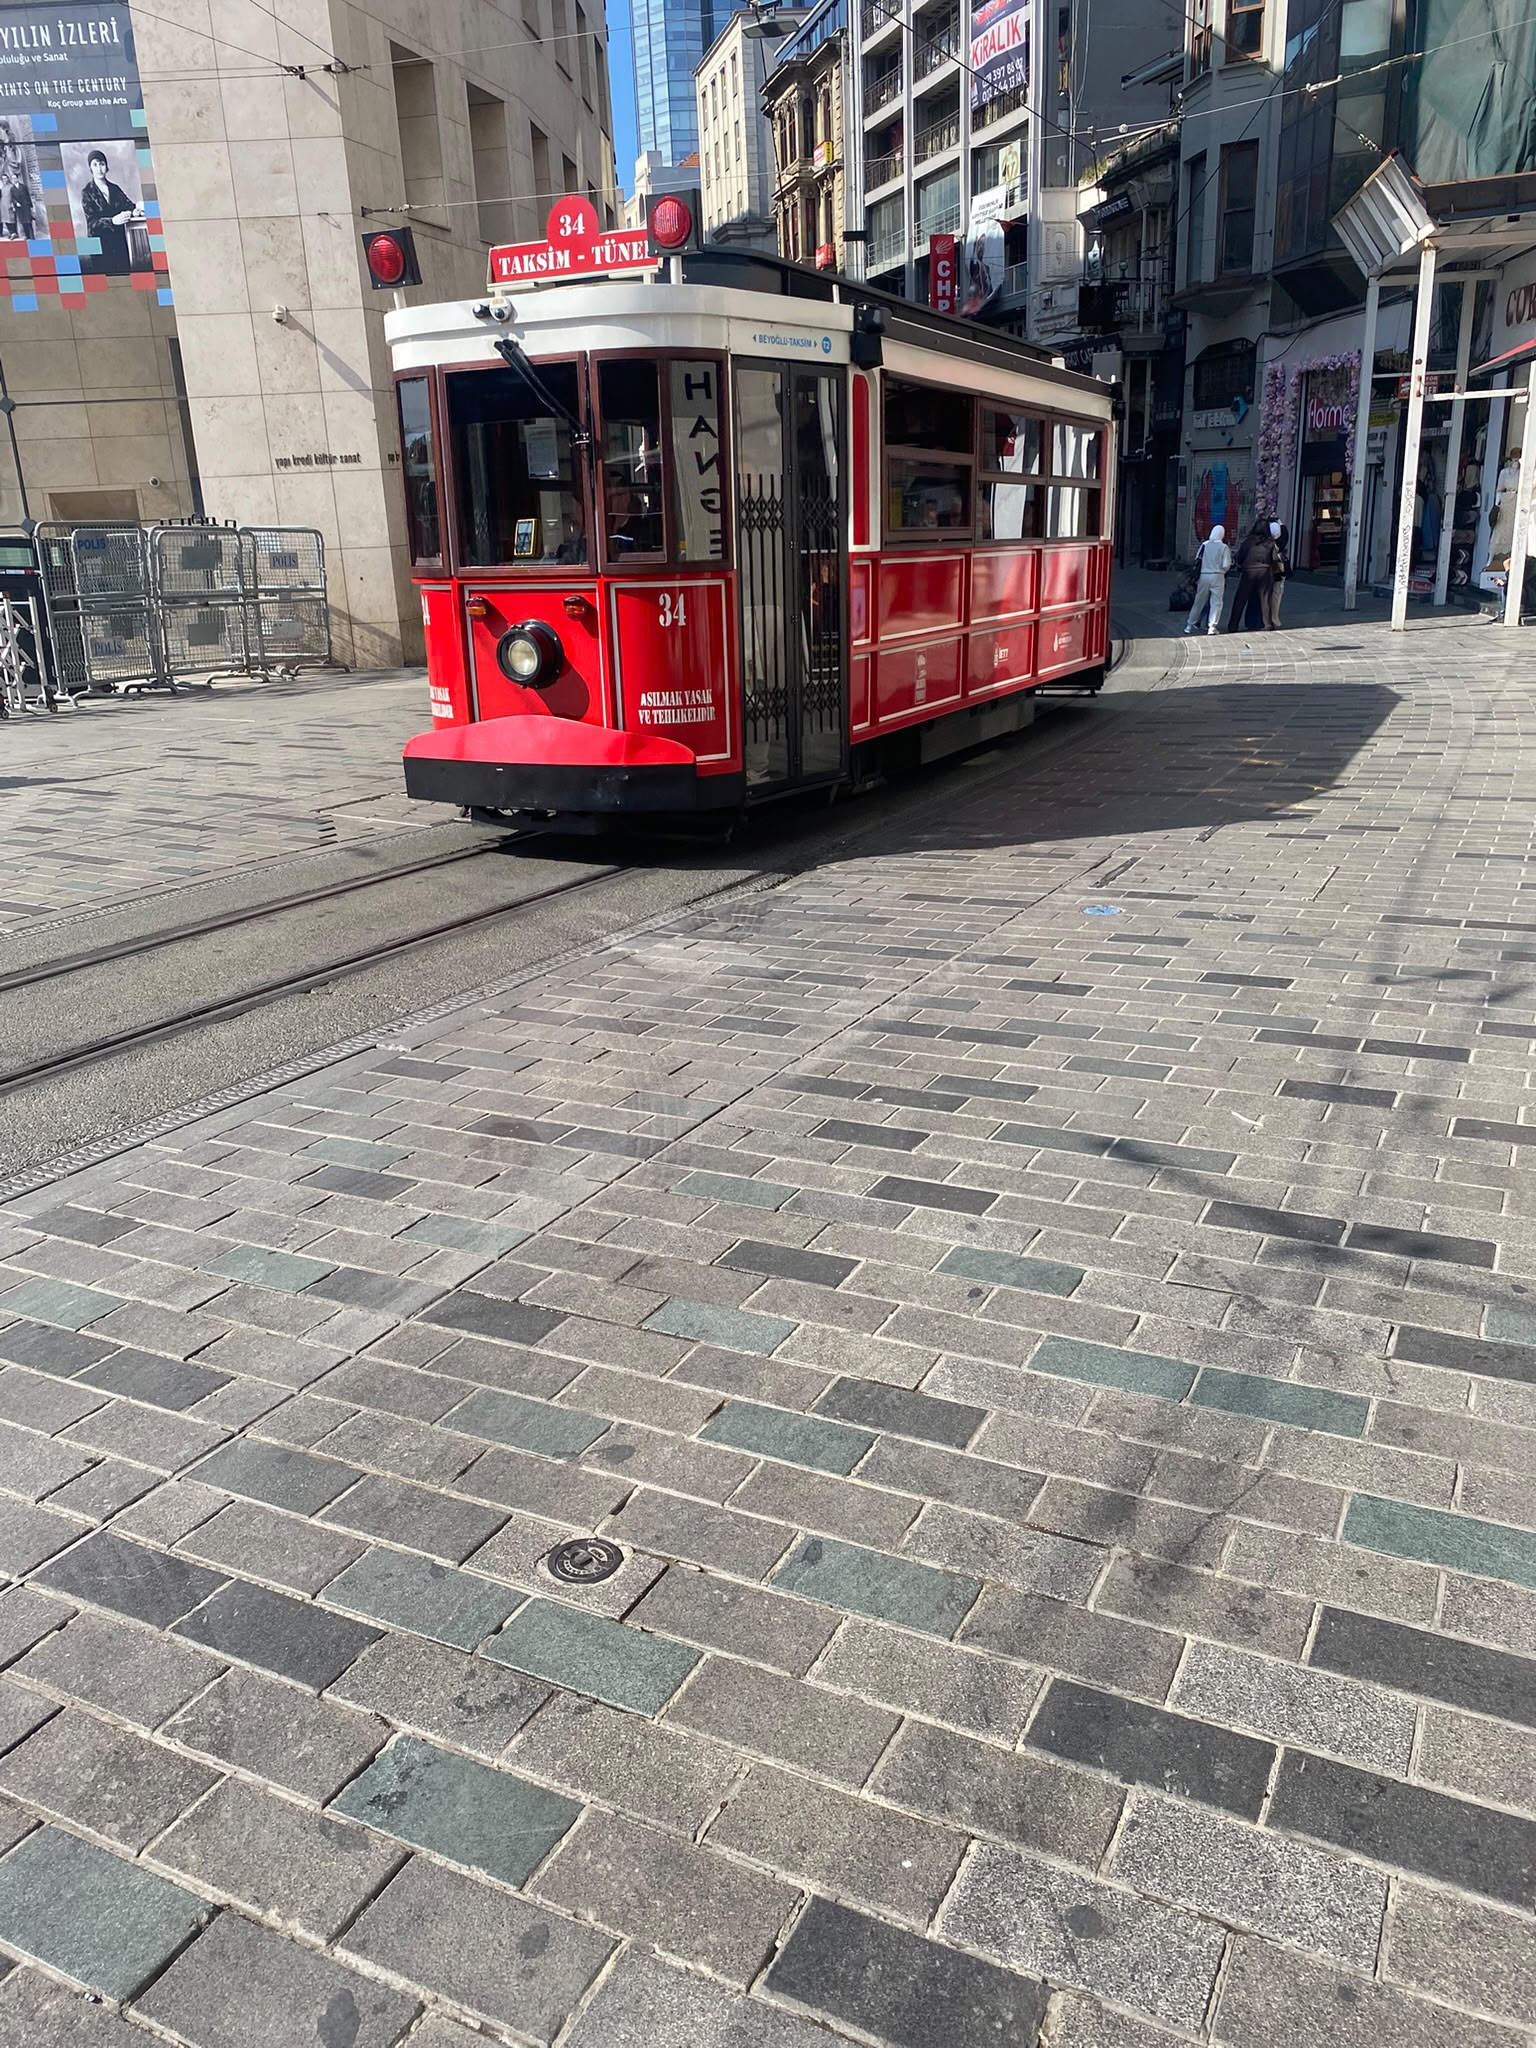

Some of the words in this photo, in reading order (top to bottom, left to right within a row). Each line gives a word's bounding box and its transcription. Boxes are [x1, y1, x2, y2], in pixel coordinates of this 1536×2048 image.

[57, 16, 120, 46] İZLERİ
[31, 55, 42, 63] ve
[43, 52, 69, 62] Sanat
[34, 80, 50, 95] ON
[52, 79, 74, 95] THE
[77, 76, 127, 94] CENTURY
[47, 100, 61, 110] Koç
[62, 99, 84, 109] Group
[85, 97, 98, 106] and
[99, 97, 111, 105] the
[112, 97, 128, 105] Arts
[559, 212, 585, 237] 34
[498, 245, 571, 276] TAKSİM
[339, 451, 362, 465] sanat
[658, 593, 687, 627] 34
[640, 690, 683, 707] ASILMAK
[684, 688, 713, 706] YASAK
